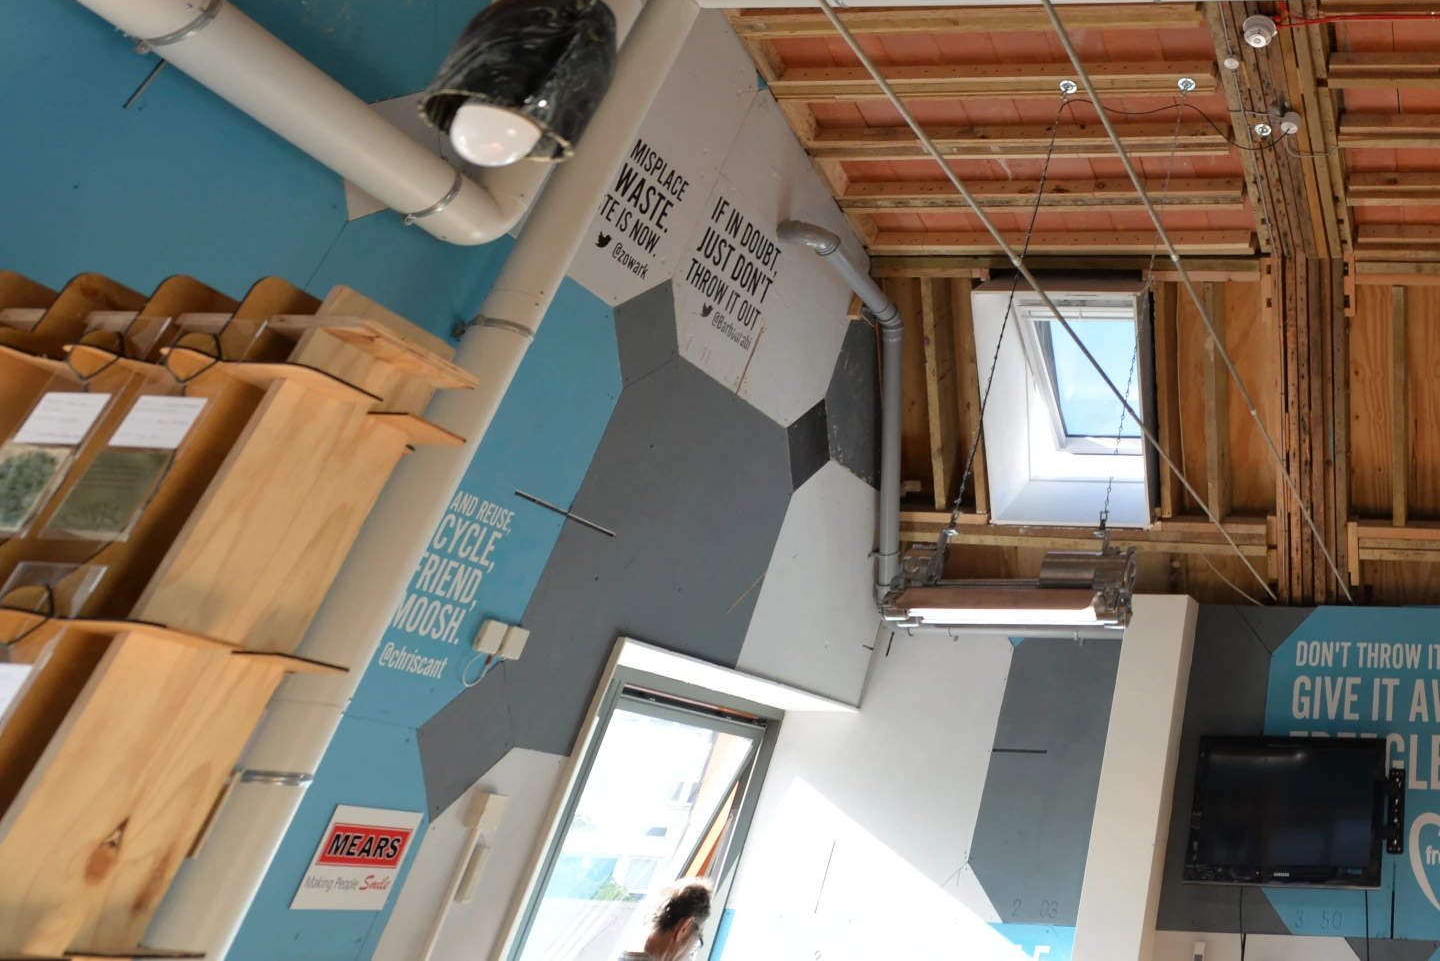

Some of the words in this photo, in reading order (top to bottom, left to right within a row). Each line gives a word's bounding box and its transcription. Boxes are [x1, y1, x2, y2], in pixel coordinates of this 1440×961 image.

[630, 138, 689, 202] MISPLACE
[614, 163, 674, 234] WASTE.
[615, 208, 632, 232] IS
[629, 221, 661, 257] NOW.
[710, 196, 729, 225] IF
[725, 208, 743, 234] IN
[740, 223, 781, 278] DOUBT,
[612, 242, 649, 280] @zowark
[697, 227, 735, 272] JUST
[730, 250, 773, 303] DON'T
[685, 258, 728, 305] THROW
[725, 290, 741, 315] IT
[737, 302, 761, 330] OUT
[450, 491, 479, 517] AND
[475, 500, 515, 535] REUSE,
[432, 514, 503, 573] CYCLE,
[378, 641, 448, 679] @chriscant
[1295, 640, 1351, 668] DON'T
[1356, 642, 1422, 670] THROW
[1292, 675, 1362, 721] GIVE
[1371, 678, 1400, 722] IT
[327, 833, 401, 859] MEARS
[304, 876, 333, 892] Making
[334, 877, 360, 892] People
[359, 875, 390, 890] Smile
